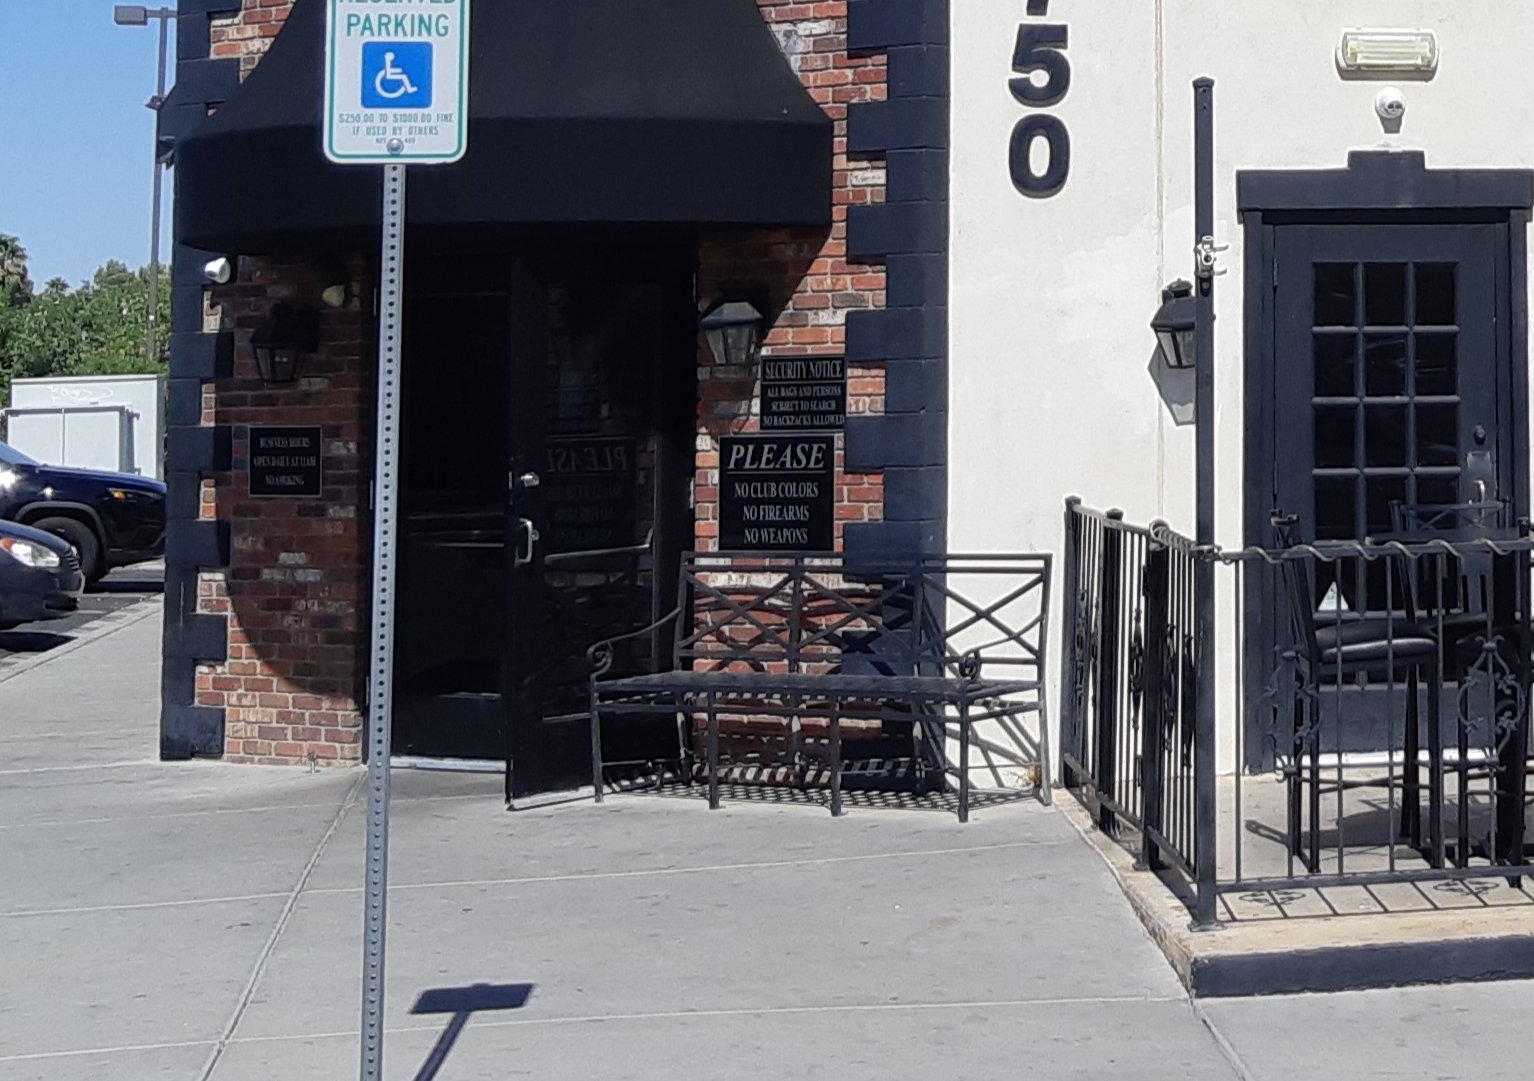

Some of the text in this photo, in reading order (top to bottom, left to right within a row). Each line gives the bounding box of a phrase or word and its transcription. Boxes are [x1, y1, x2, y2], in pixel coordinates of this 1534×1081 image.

[346, 13, 450, 37] PARKING
[338, 113, 375, 124] $250.00
[379, 113, 388, 124] TO
[436, 113, 455, 124] FINE
[352, 125, 439, 136] IF USED BY OTHERS
[765, 360, 843, 379] SECURITY NOTICE
[767, 385, 842, 397] ALL BAGS AND PERSONS
[771, 400, 836, 412] SUBJECT TO SEARCH
[763, 414, 845, 426] NO BACKPACKS ALLOWED
[727, 442, 827, 470] PLEASE
[734, 482, 819, 498] NO CLUB COLORS
[743, 505, 810, 521] NO FIREARMS
[744, 528, 808, 544] NO WEAPONS
